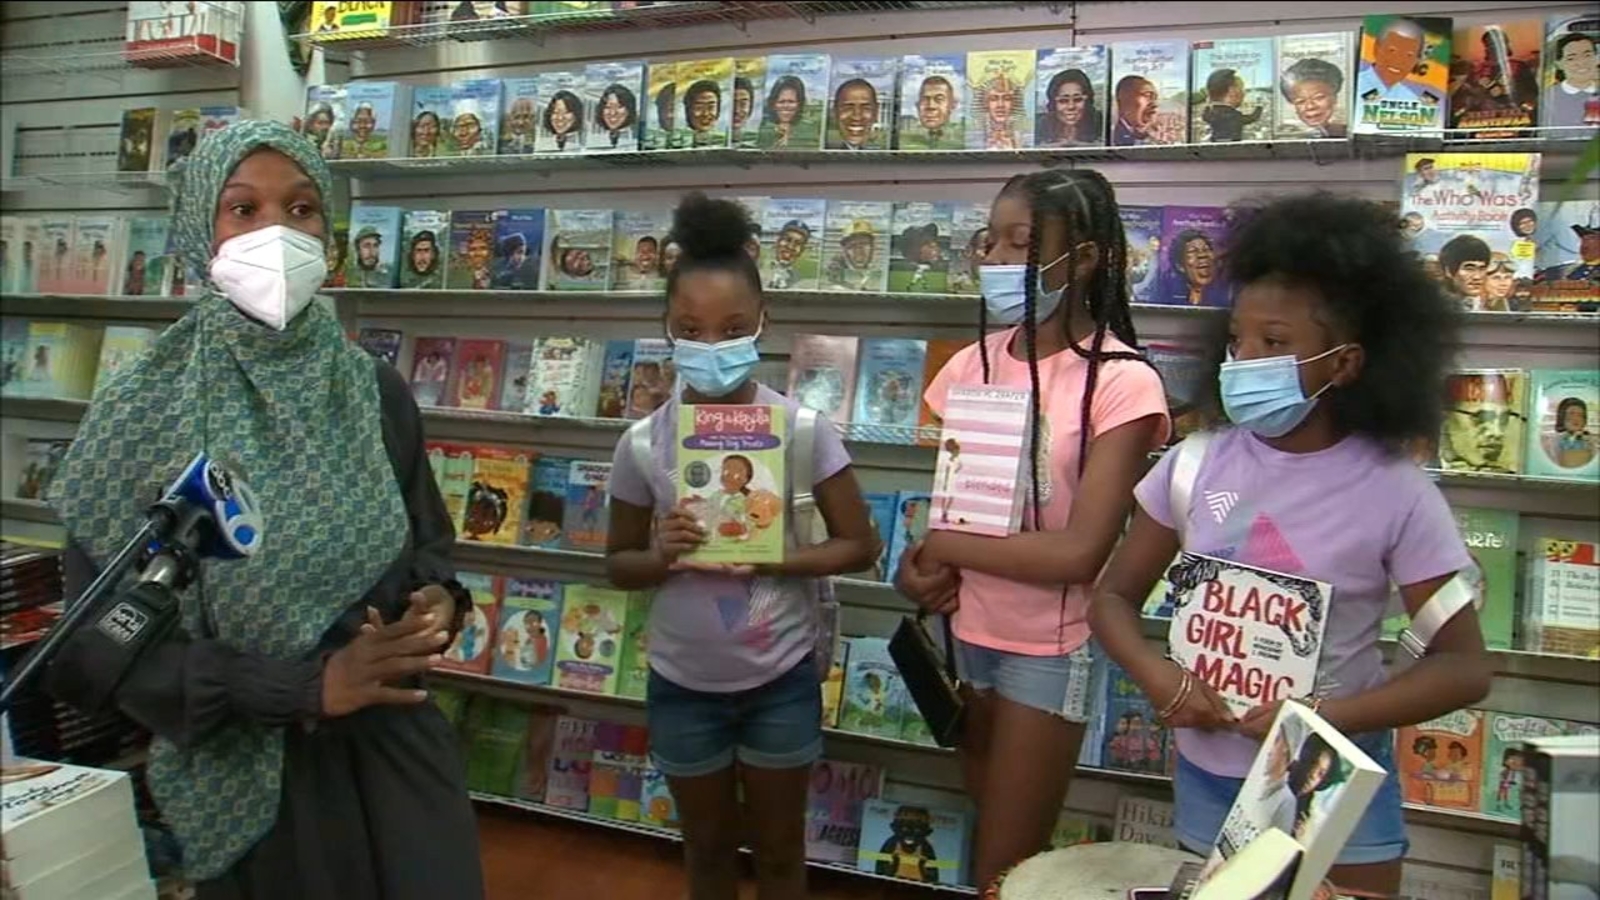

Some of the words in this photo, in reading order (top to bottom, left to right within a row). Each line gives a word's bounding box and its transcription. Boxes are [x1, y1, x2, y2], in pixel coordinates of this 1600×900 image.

[1362, 104, 1436, 125] NELSON
[1380, 100, 1418, 110] UNCLE
[1412, 195, 1433, 206] The
[1433, 189, 1474, 207] Who
[696, 409, 724, 432] King
[732, 407, 769, 432] Kayla
[1203, 580, 1306, 632] BLACK
[1186, 613, 1247, 660] GIRL
[1194, 653, 1294, 703] MAGIC
